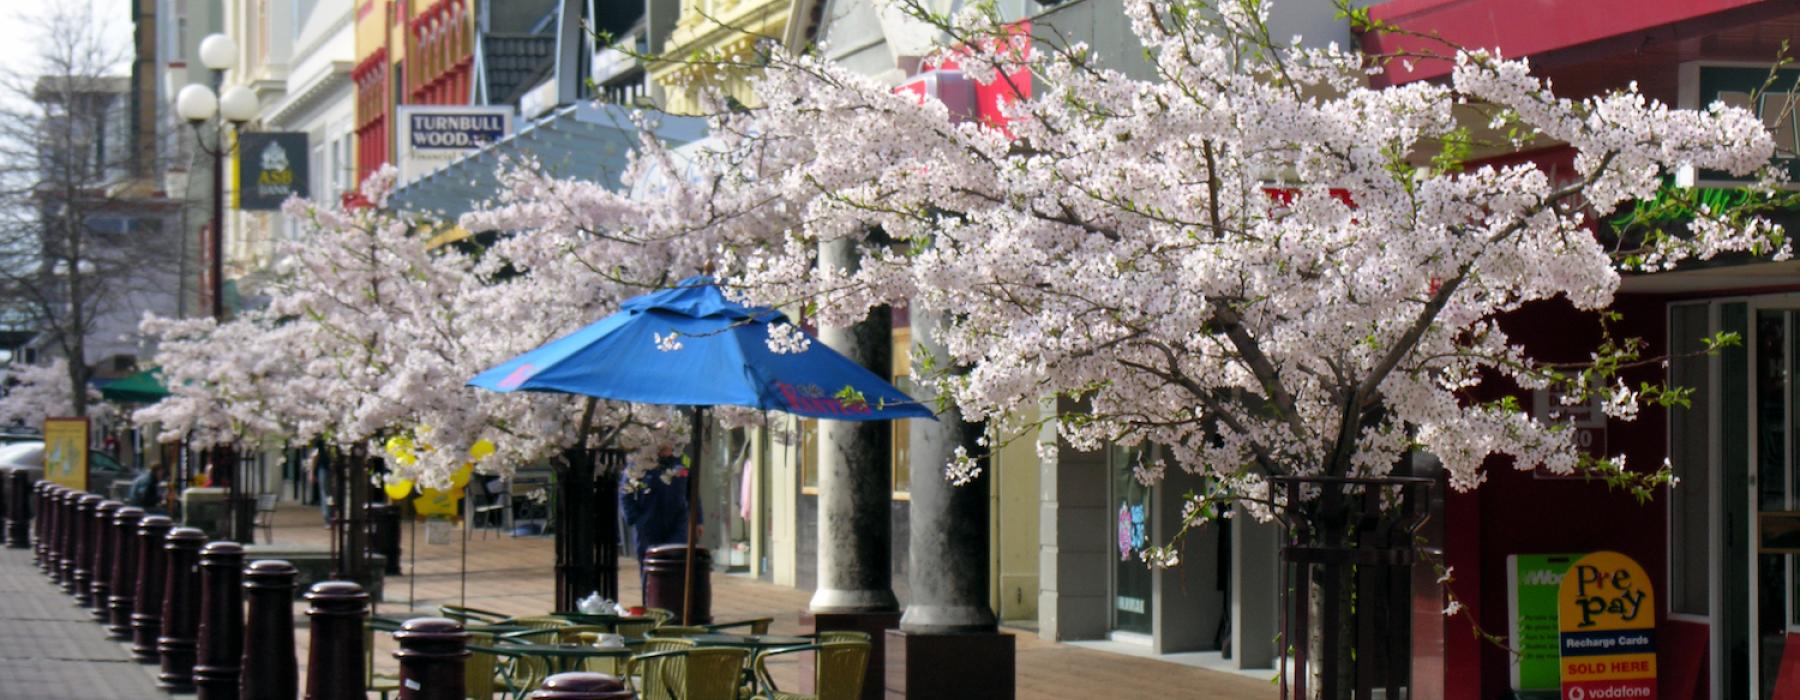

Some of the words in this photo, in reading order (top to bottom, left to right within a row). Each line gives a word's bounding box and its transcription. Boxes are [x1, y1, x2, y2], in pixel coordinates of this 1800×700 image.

[413, 115, 502, 131] TURNBULL
[1575, 565, 1632, 597] Pre
[1575, 589, 1647, 629] pay
[1566, 636, 1616, 649] Recharge
[1618, 635, 1649, 646] Cards
[1568, 664, 1606, 675] SOLD
[1611, 661, 1649, 673] HERE
[1588, 686, 1651, 699] vodafone
